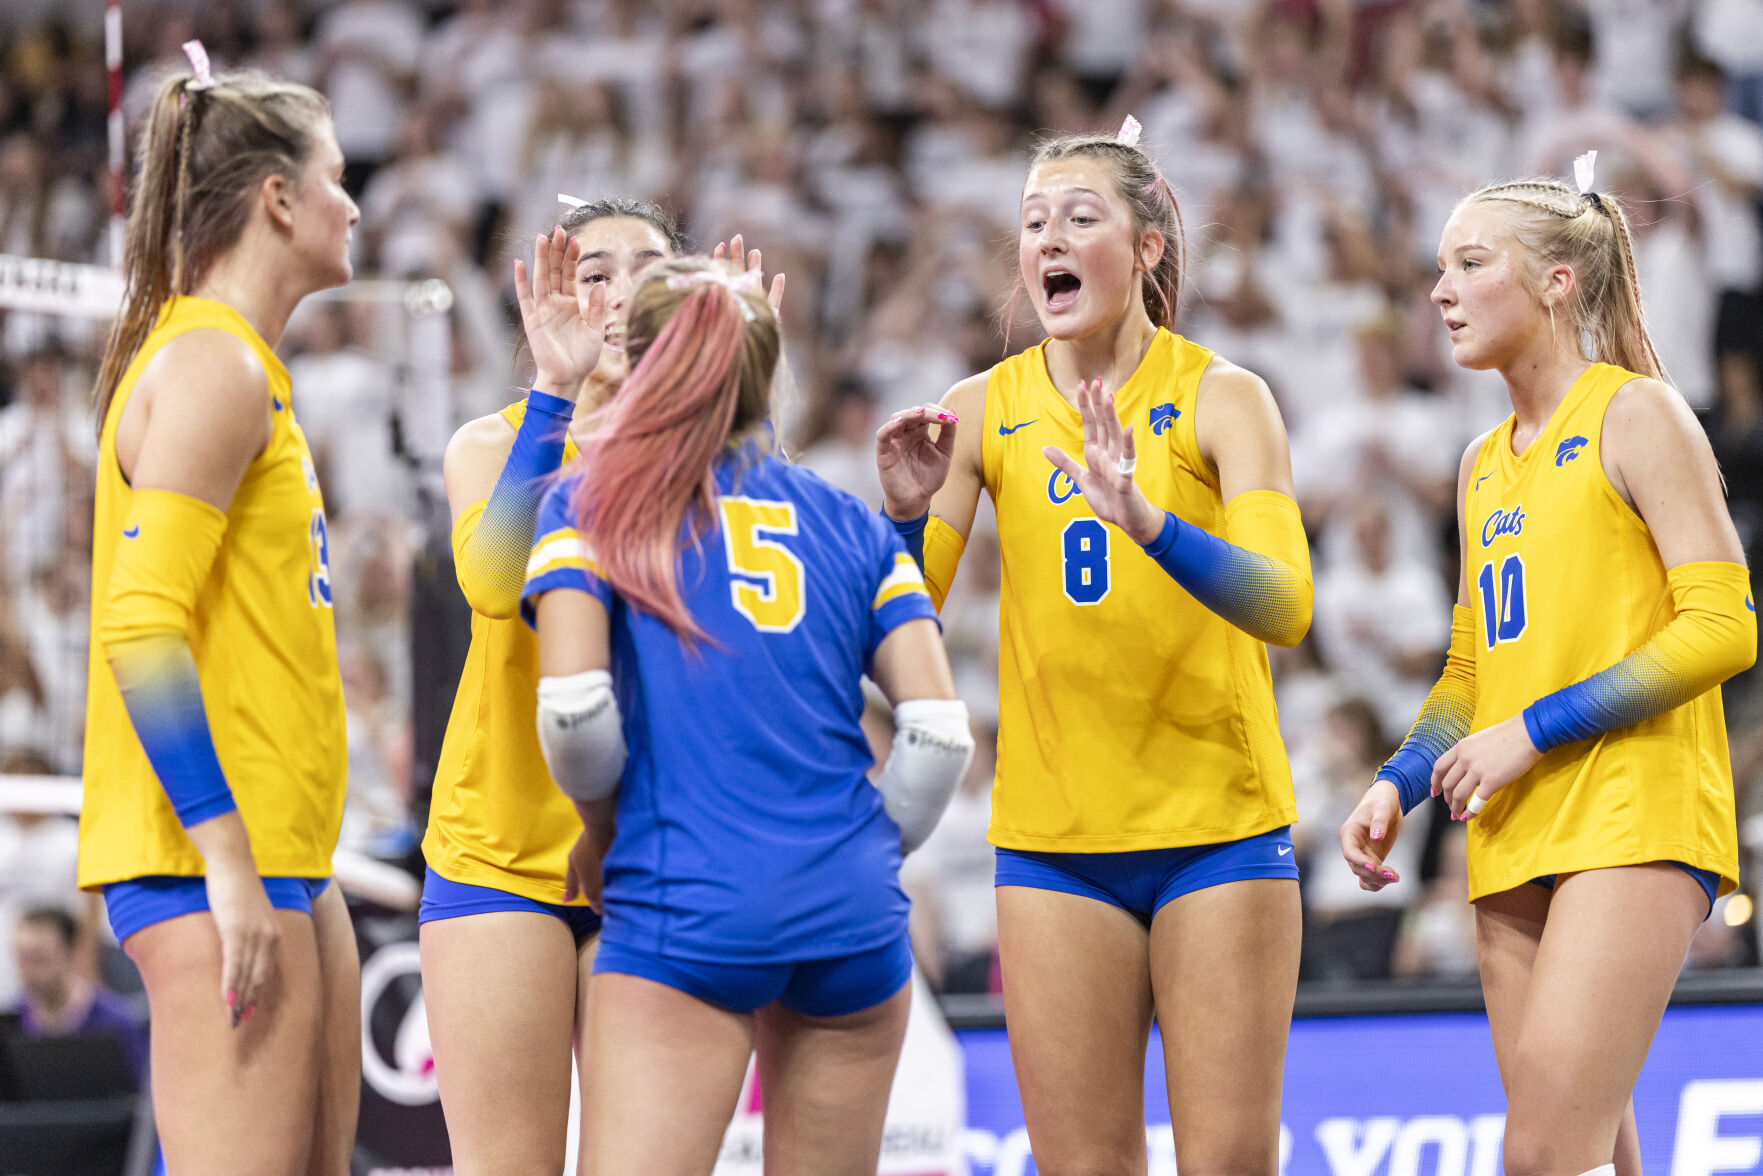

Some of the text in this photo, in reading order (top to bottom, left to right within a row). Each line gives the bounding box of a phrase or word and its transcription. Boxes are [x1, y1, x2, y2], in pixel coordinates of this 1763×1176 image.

[718, 495, 807, 634] 5
[1060, 517, 1111, 606] 8
[1481, 504, 1526, 548] Cats
[1478, 552, 1529, 652] 10
